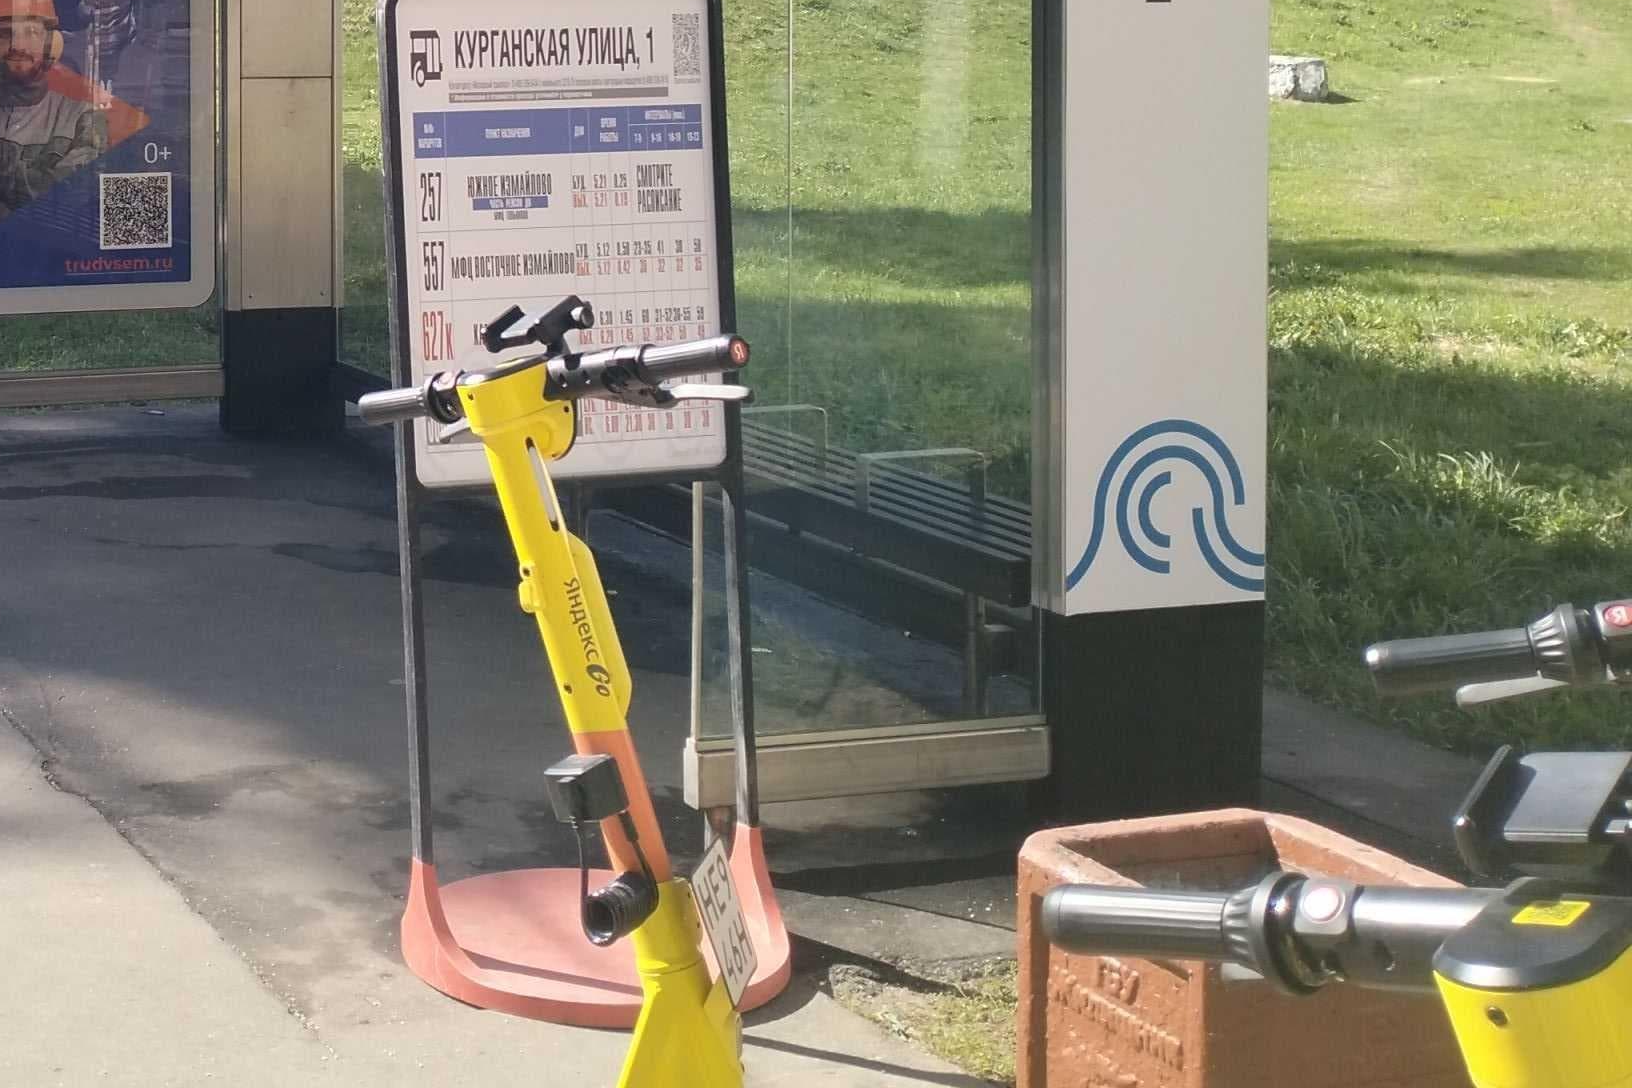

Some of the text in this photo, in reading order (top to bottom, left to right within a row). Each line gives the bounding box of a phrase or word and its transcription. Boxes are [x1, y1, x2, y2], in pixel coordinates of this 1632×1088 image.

[454, 26, 655, 71] КУРГАНСКАЯ УЛИЦА, 1
[144, 142, 172, 164] 0+
[467, 170, 552, 198] ЮЖНОЕ ИЗМАЙЛОВО
[636, 163, 673, 188] СМОТРИТЕ
[420, 172, 442, 222] 257
[637, 188, 683, 213] РАСПИСАНИЕ
[64, 257, 174, 273] trudvsem.ru
[423, 241, 445, 291] 557
[451, 249, 575, 281] МФЦ ВОСТОЧНОЕ ИЗМАЙЛОВО
[564, 577, 600, 663] Яндекс
